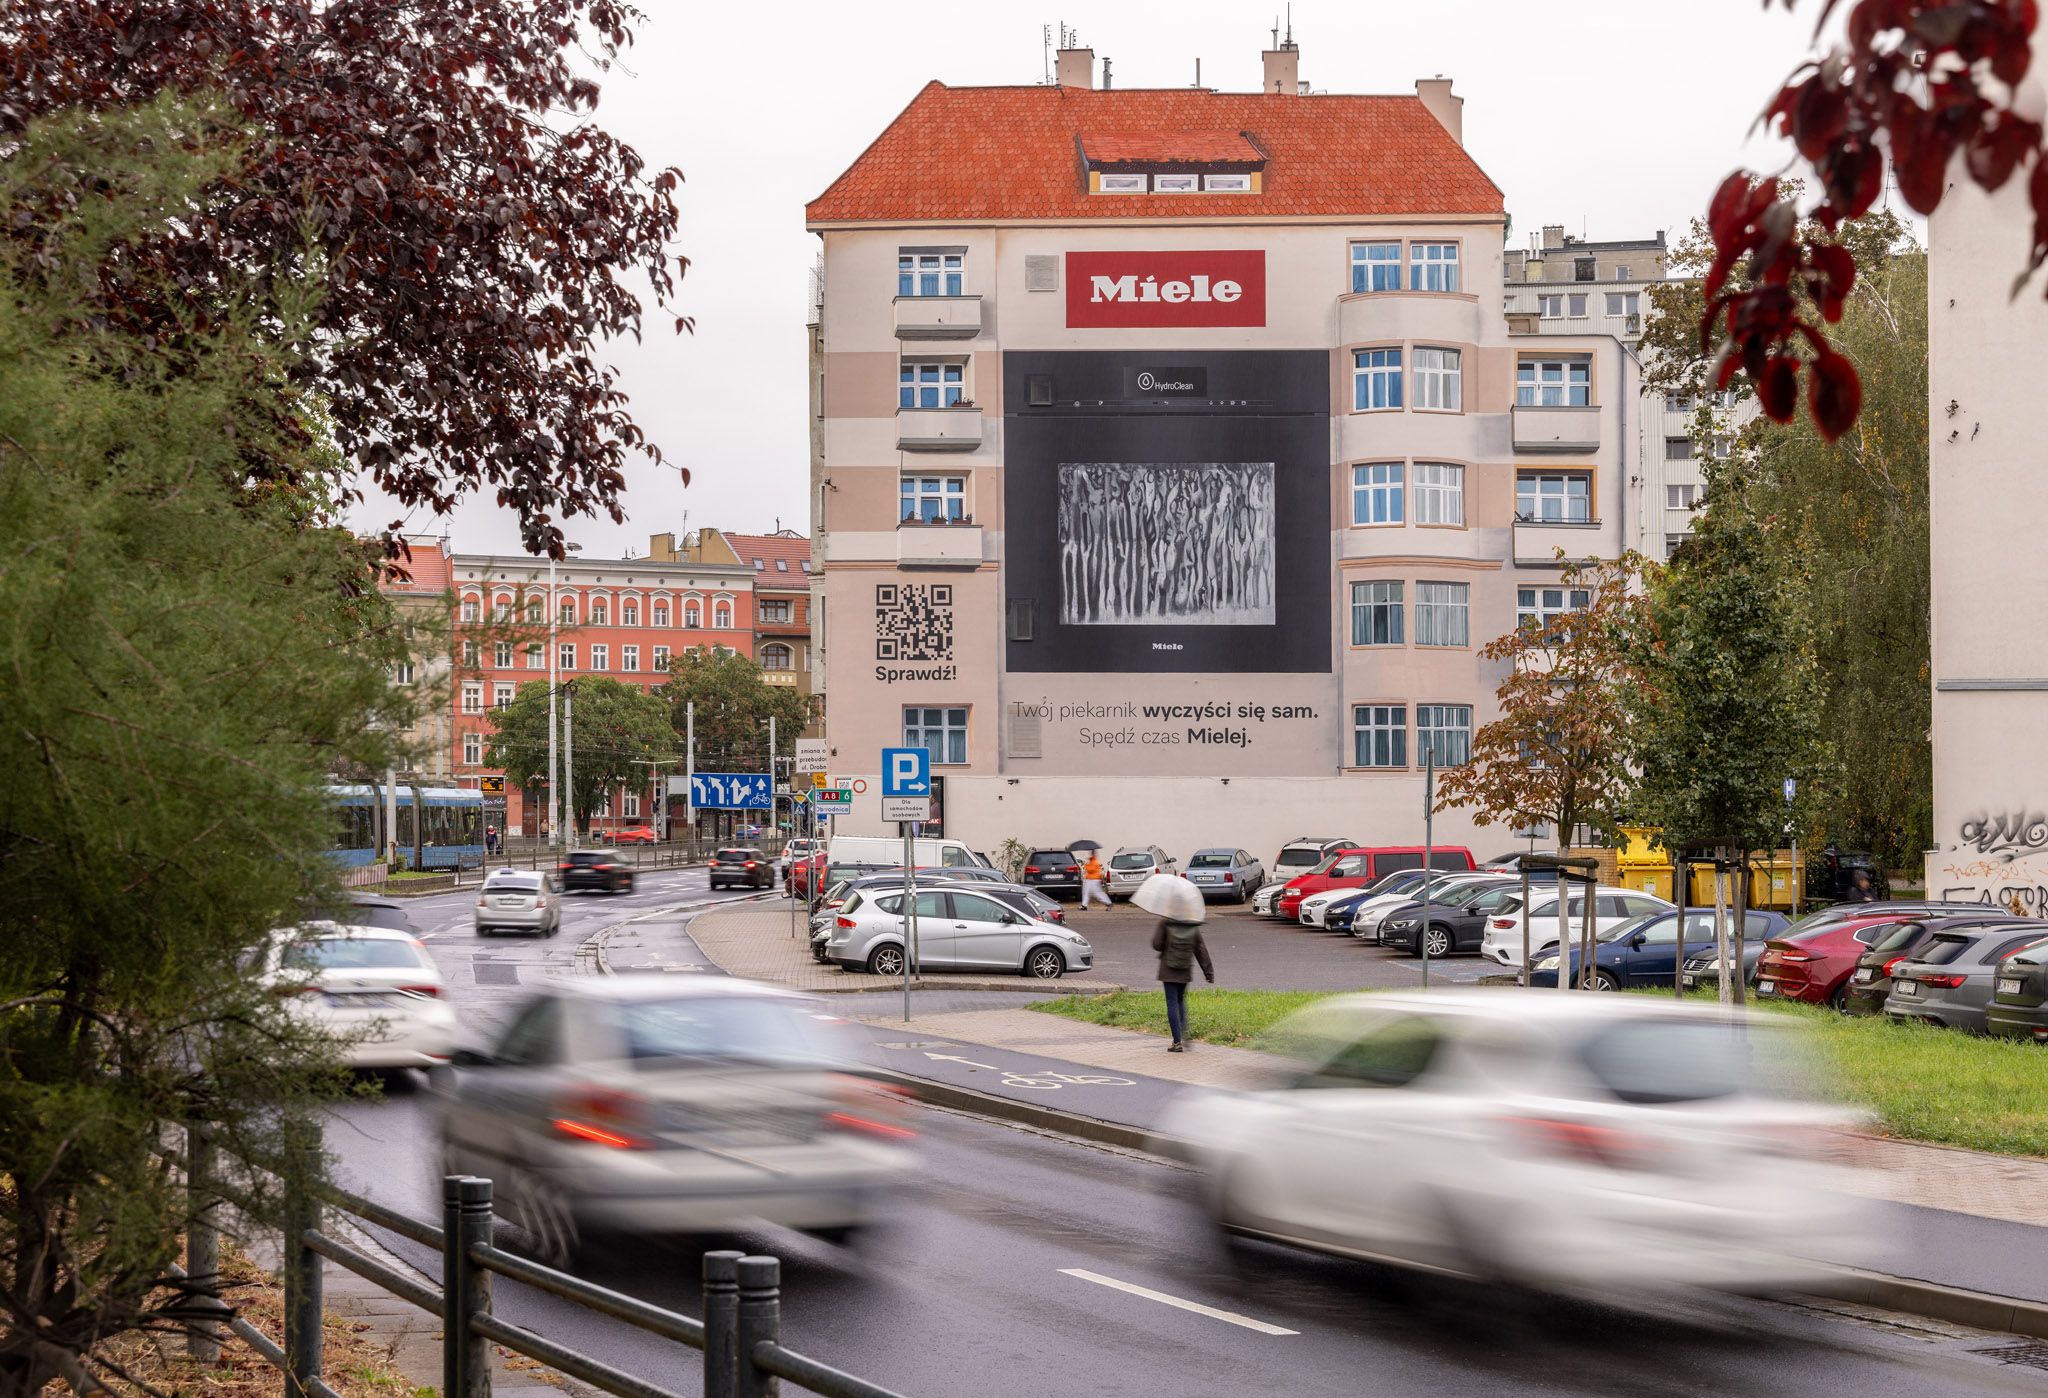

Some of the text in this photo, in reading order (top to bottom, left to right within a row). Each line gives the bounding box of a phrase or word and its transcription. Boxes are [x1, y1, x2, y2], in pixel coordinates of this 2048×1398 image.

[1090, 275, 1242, 303] Miele
[1154, 381, 1194, 392] HydroClean
[1152, 643, 1184, 651] Miele
[875, 665, 957, 684] Sprawdź!
[1012, 701, 1319, 722] Twój piekarnik wyczyści się sam.
[1079, 727, 1252, 748] Spędź czas Mielej.
[892, 753, 920, 791] P
